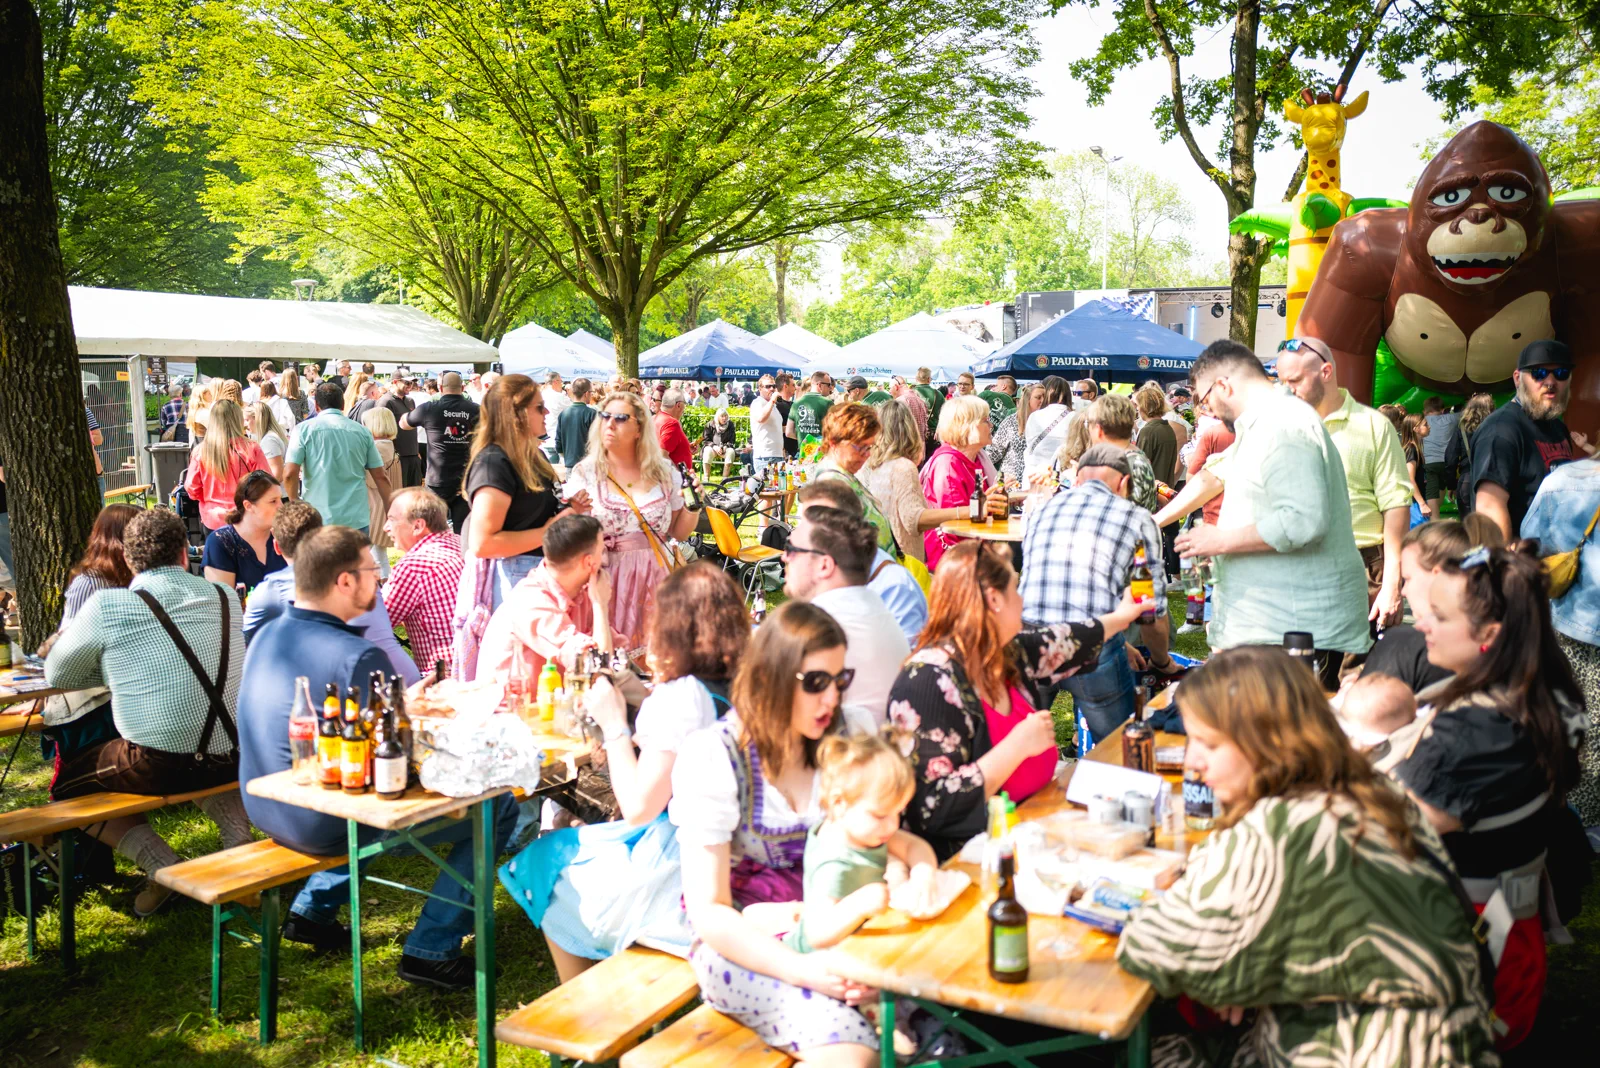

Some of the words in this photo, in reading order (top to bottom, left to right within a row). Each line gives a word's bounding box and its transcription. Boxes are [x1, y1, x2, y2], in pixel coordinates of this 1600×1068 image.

[1051, 356, 1109, 366] PAULANER
[1152, 358, 1195, 369] PAULAN
[724, 368, 760, 376] PAULANER
[443, 410, 470, 420] Security
